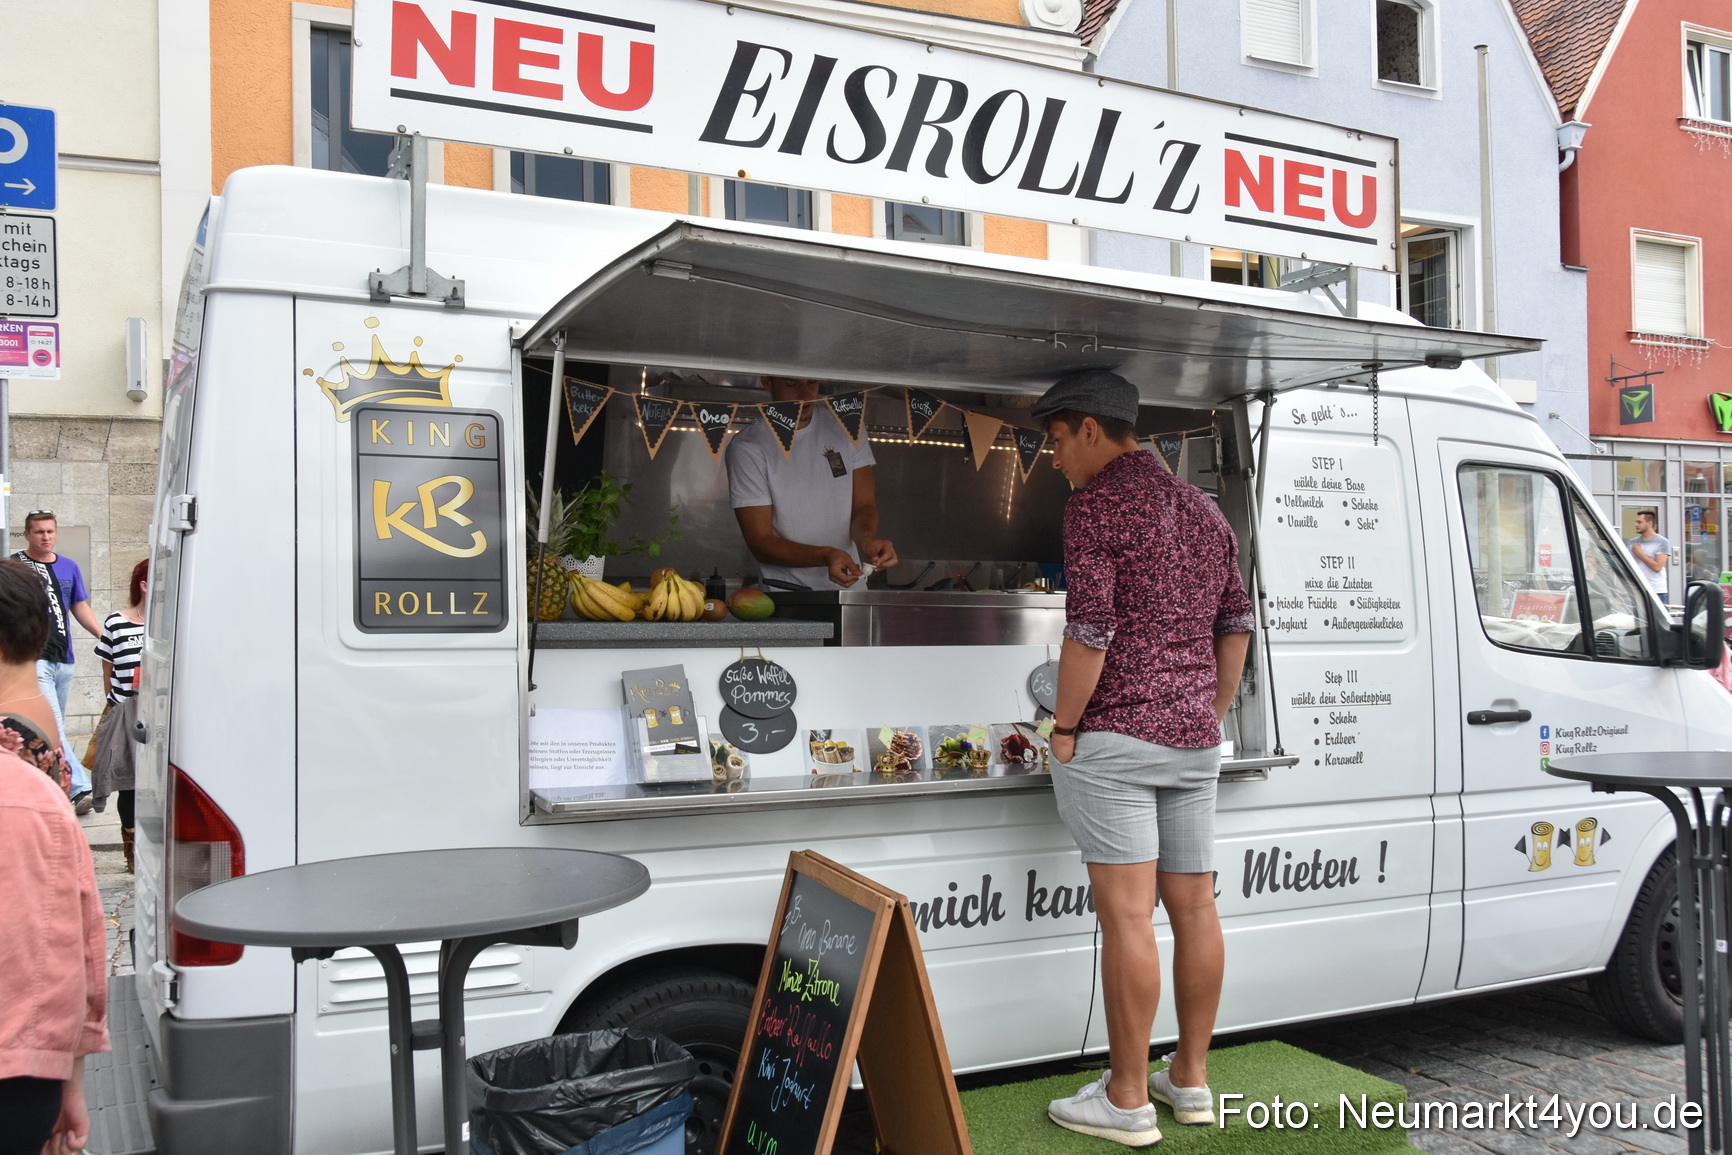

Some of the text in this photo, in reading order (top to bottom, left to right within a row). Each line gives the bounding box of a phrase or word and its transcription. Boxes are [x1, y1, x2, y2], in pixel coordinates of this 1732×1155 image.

[391, 2, 655, 111] NEU
[1224, 148, 1377, 229] NEU
[4, 222, 31, 235] mit
[1, 238, 47, 253] chein
[700, 409, 730, 424] Oreo
[766, 406, 796, 428] Banane
[1291, 408, 1308, 425] So
[371, 419, 486, 449] KING
[1019, 435, 1037, 449] Kiwi
[1311, 456, 1336, 470] STEP
[1294, 476, 1366, 491] wähle deine Base
[1284, 494, 1324, 508] Vollmilch
[1351, 498, 1379, 511] Schoko
[1287, 515, 1319, 528] Vanille
[1320, 556, 1344, 569] STEP
[1304, 576, 1373, 590] mixe die Zutaten
[374, 591, 489, 616] ROLLZ
[1307, 596, 1338, 610] Früchte
[1356, 596, 1401, 612] Süßigkeiten
[1275, 616, 1308, 633] Joghurt
[1331, 616, 1404, 632] Außergewöhnliches
[756, 665, 791, 686] Waffel
[1324, 670, 1343, 686] Step
[730, 684, 791, 710] Pommes
[1291, 690, 1391, 706] wähle dein Soßentopping
[1329, 710, 1358, 725] Schoko
[1324, 751, 1364, 767] Karamell
[1025, 869, 1098, 922] kan
[1242, 846, 1361, 899] Mieten
[778, 958, 841, 1007] Minze Zitrone
